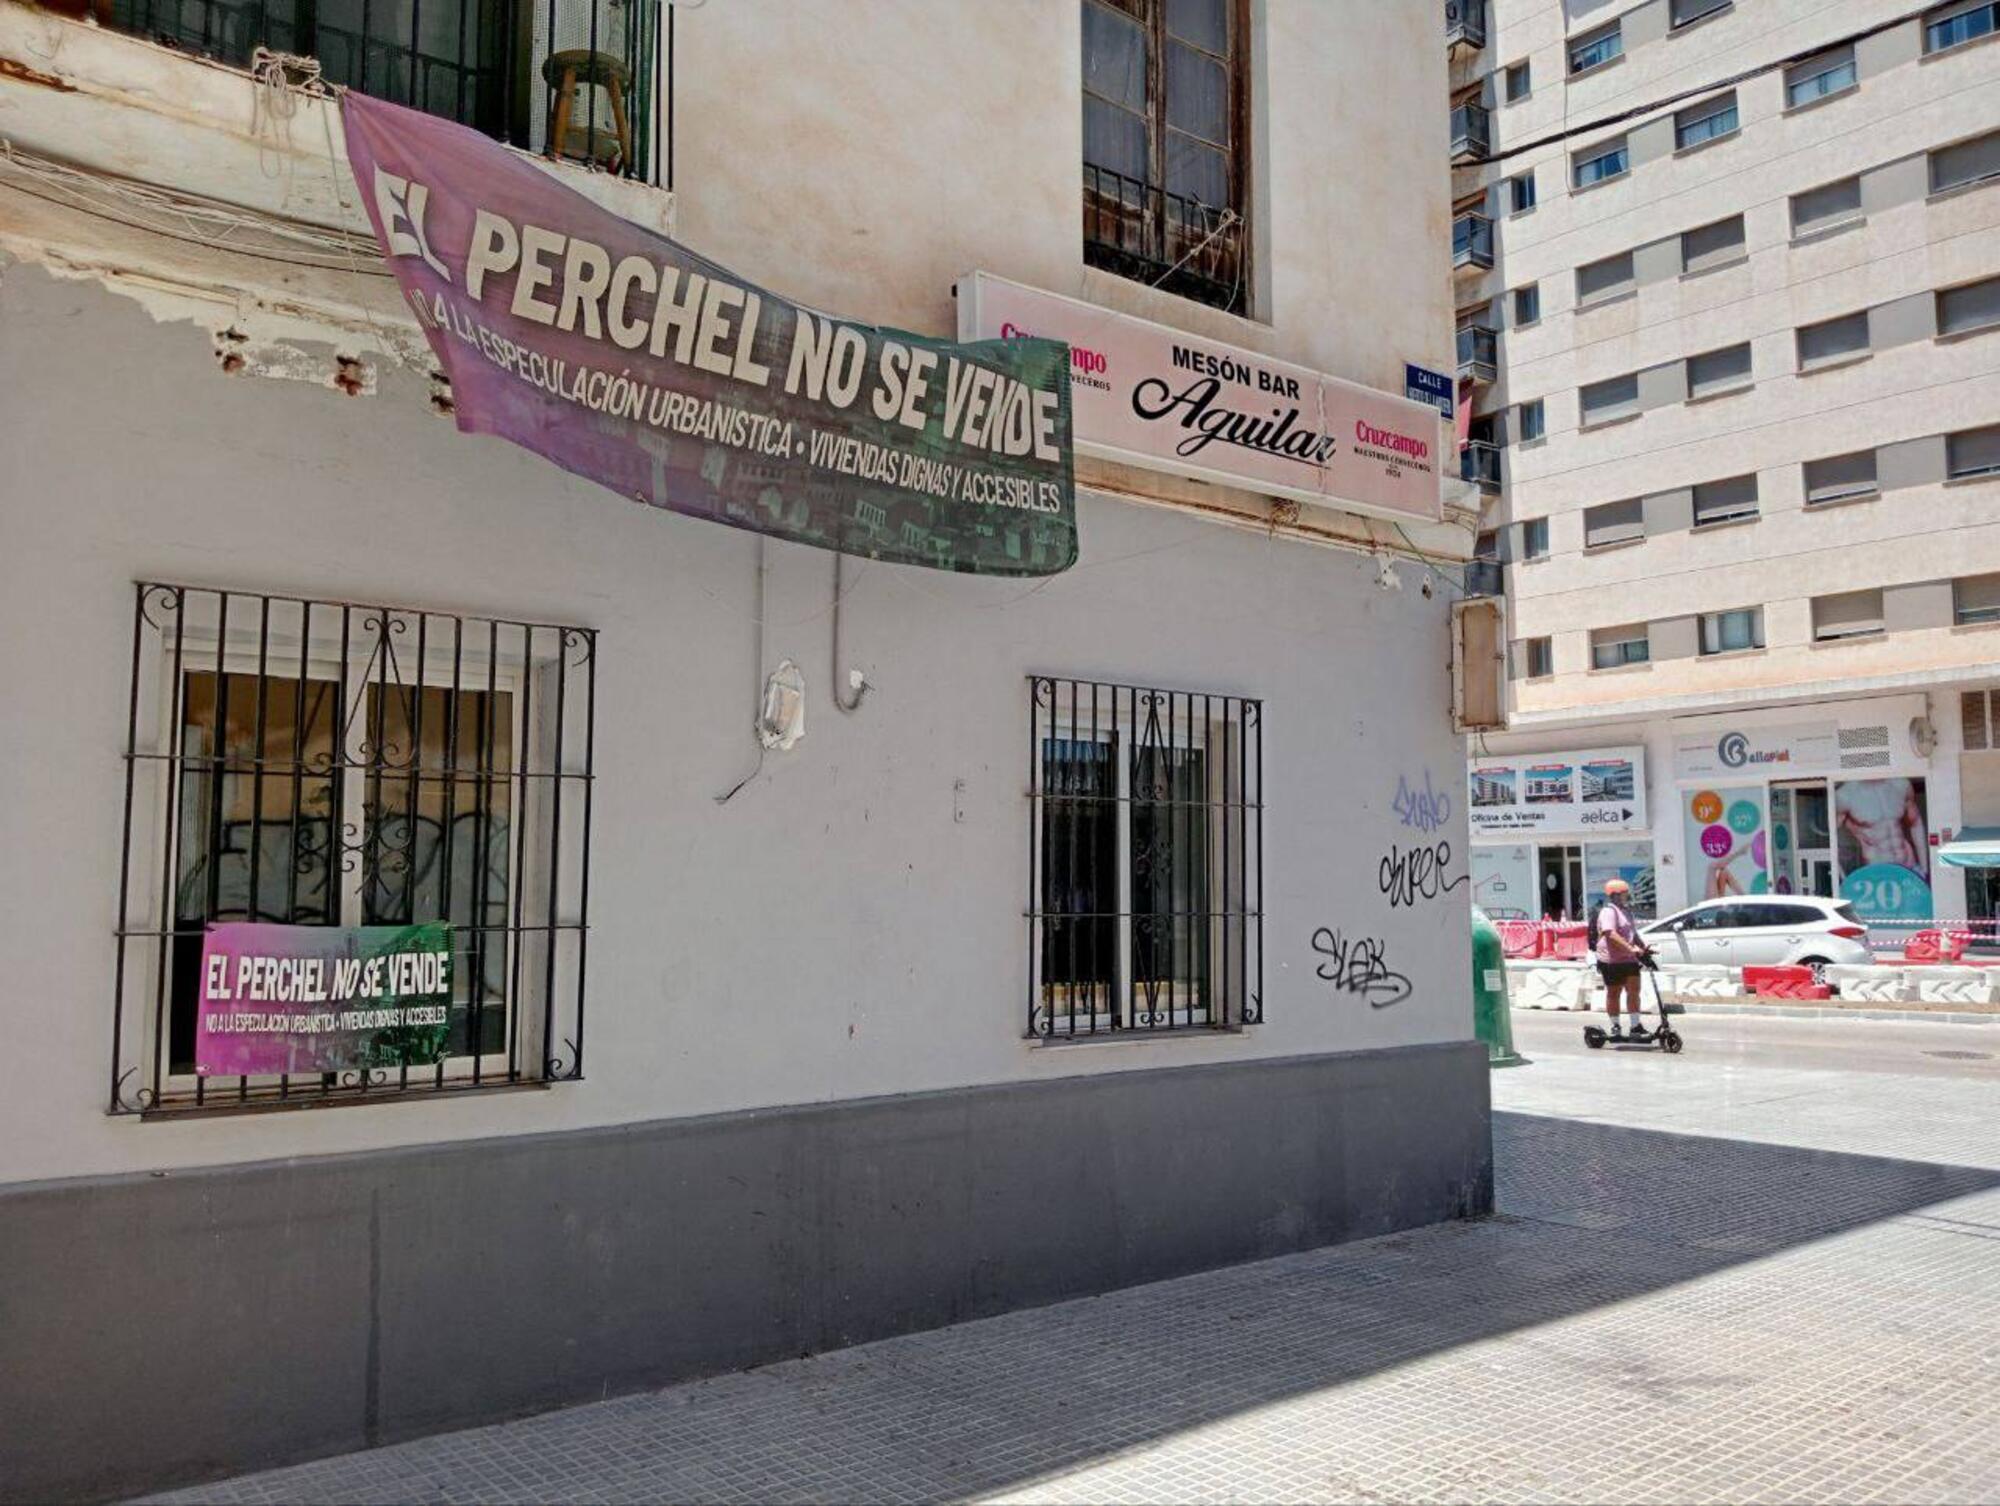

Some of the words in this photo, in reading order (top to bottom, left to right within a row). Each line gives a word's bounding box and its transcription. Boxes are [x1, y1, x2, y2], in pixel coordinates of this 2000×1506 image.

[374, 160, 450, 281] EL
[466, 209, 769, 386] PERCHEL
[785, 309, 866, 409] NO
[872, 340, 938, 431] SE
[942, 357, 1060, 462] VENDE
[1172, 346, 1250, 386] MESÓN
[1258, 369, 1300, 400] BAR
[434, 292, 450, 331] A
[450, 303, 481, 352] LA
[478, 324, 649, 422] ESPECULACIÓN
[647, 387, 792, 459] URBANISTICA
[808, 429, 899, 485] VIVIENDAS
[899, 453, 952, 499] DIGNAS
[951, 469, 963, 499] Y
[961, 471, 1061, 514] ACCESIBLES
[1132, 377, 1337, 470] Aguilar
[1356, 419, 1428, 460] Cruzcampo
[1516, 810, 1546, 821] Ventas
[1580, 808, 1619, 824] aelca
[206, 955, 231, 999] EL
[236, 956, 328, 1002] PERCHEL
[330, 958, 361, 1000] NO
[360, 955, 384, 998] SE
[388, 951, 449, 996] VENDE
[205, 1013, 217, 1032] NO
[217, 1013, 225, 1032] A
[224, 1013, 235, 1032] LA
